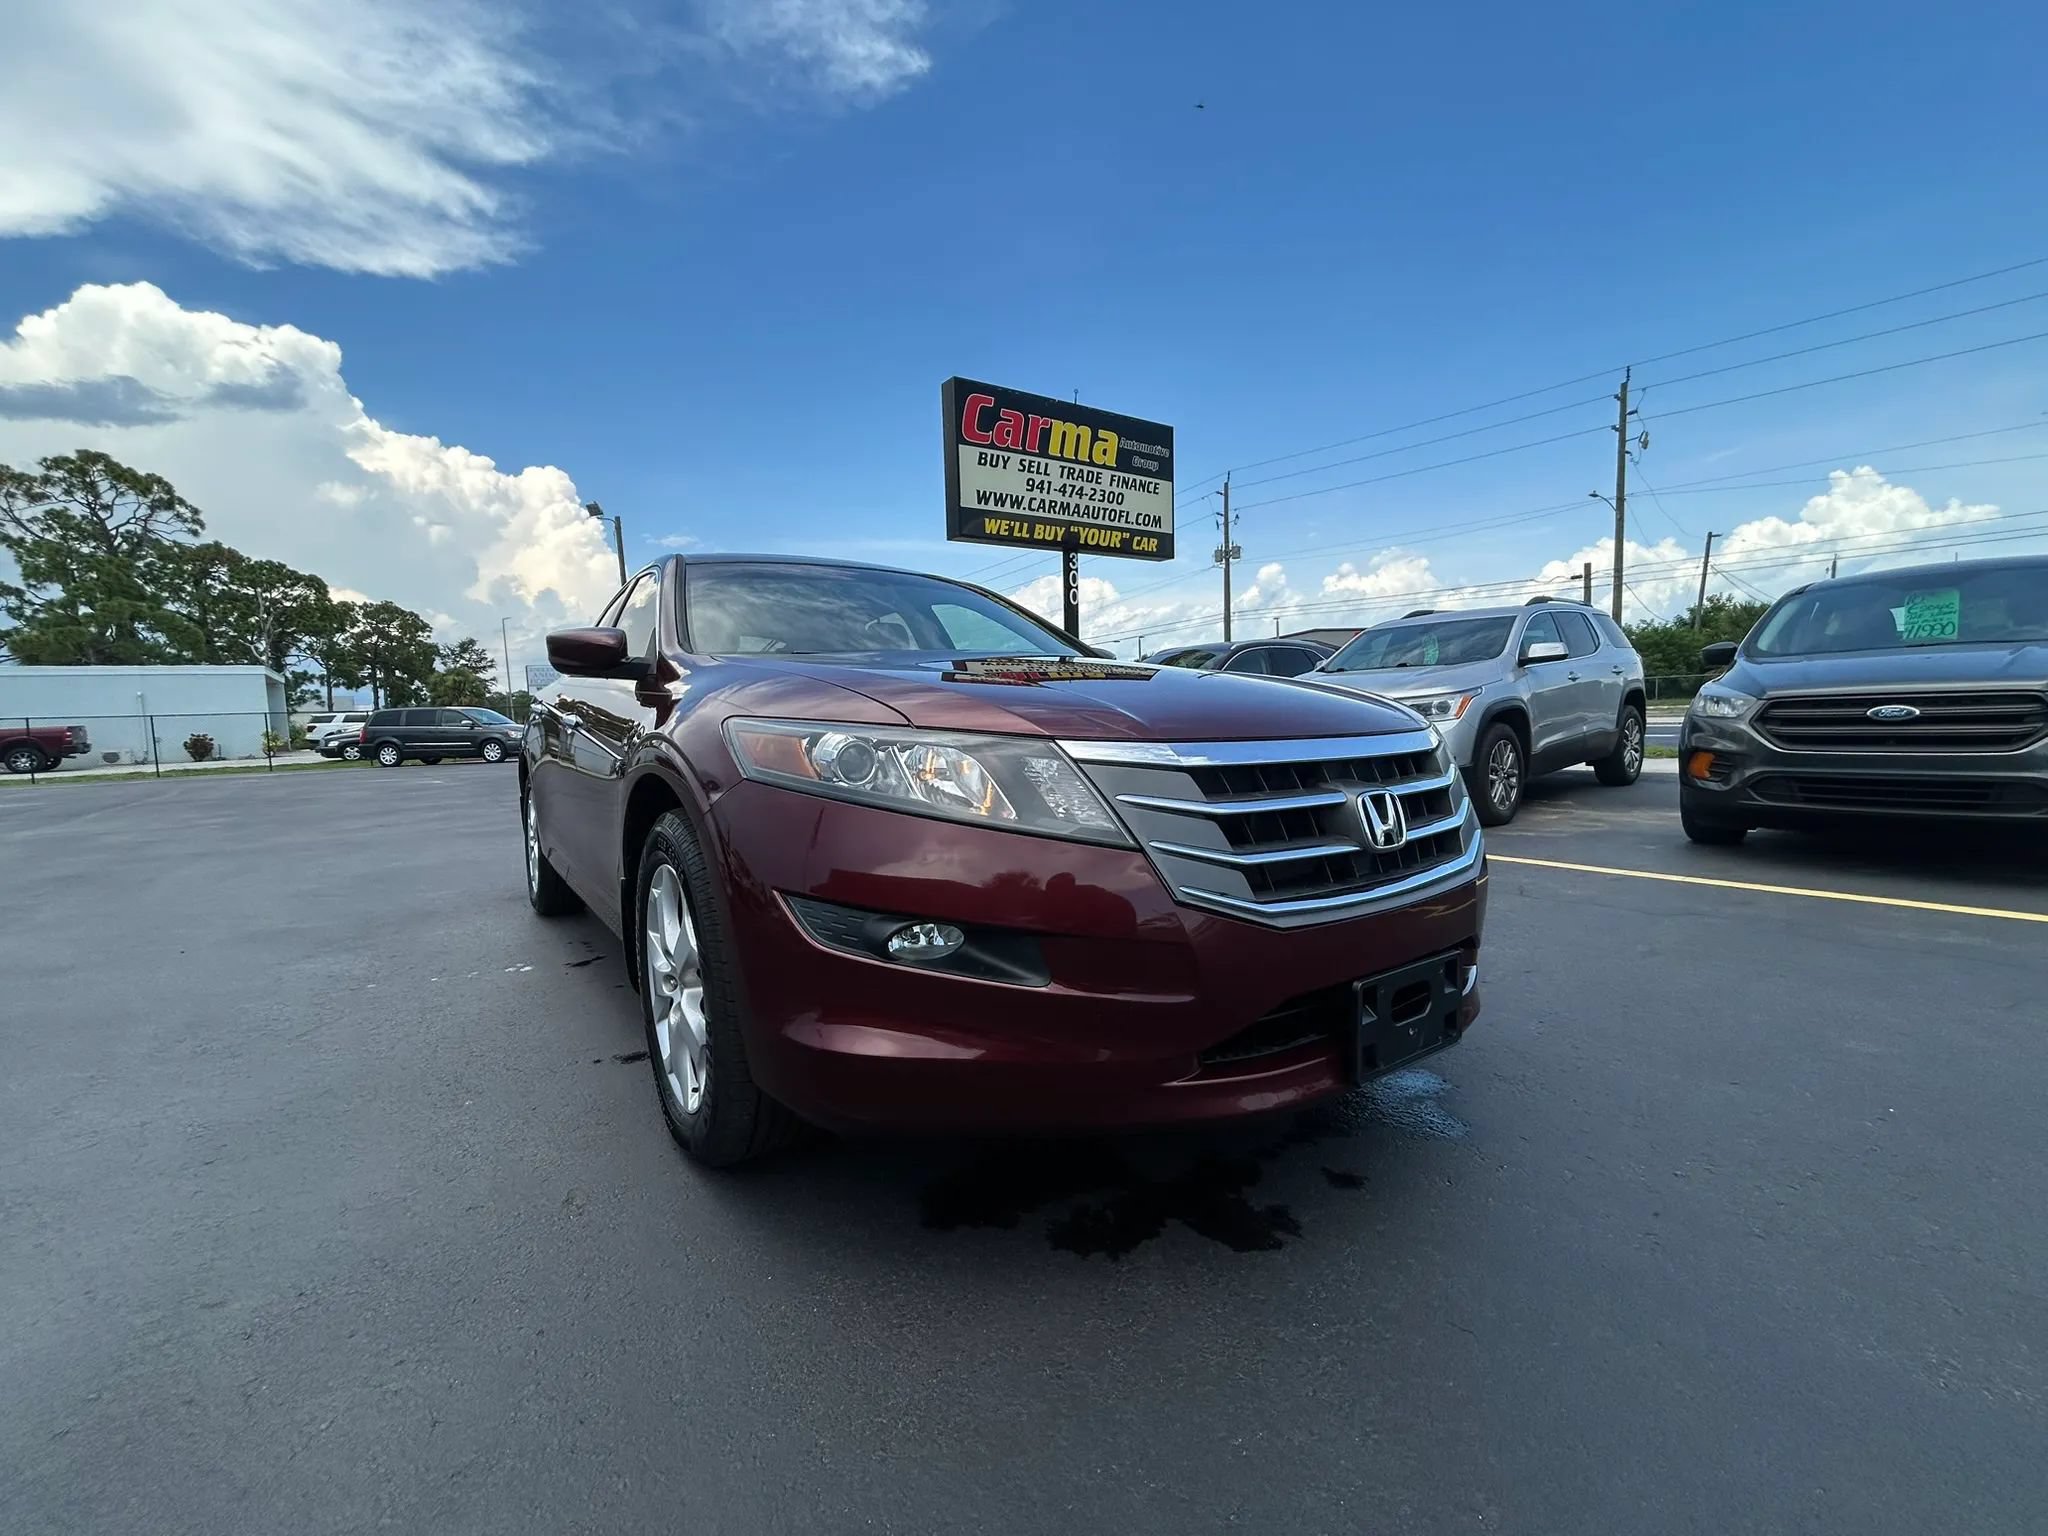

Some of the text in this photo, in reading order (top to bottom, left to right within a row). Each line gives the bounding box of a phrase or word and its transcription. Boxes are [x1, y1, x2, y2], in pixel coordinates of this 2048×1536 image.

[962, 393, 1118, 467] Carma
[1119, 437, 1170, 458] Automotive
[1132, 455, 1159, 472] Group
[977, 451, 1160, 495] BUY SELL TRADE FINANCE
[1025, 477, 1125, 506] 941-474-2300
[976, 489, 1162, 529] WWW.CARMAAUTOFL.COM
[984, 517, 1029, 538] WE'LL
[1033, 523, 1065, 541] BUY
[1132, 536, 1158, 553] CAR
[1878, 708, 1907, 717] Ford
